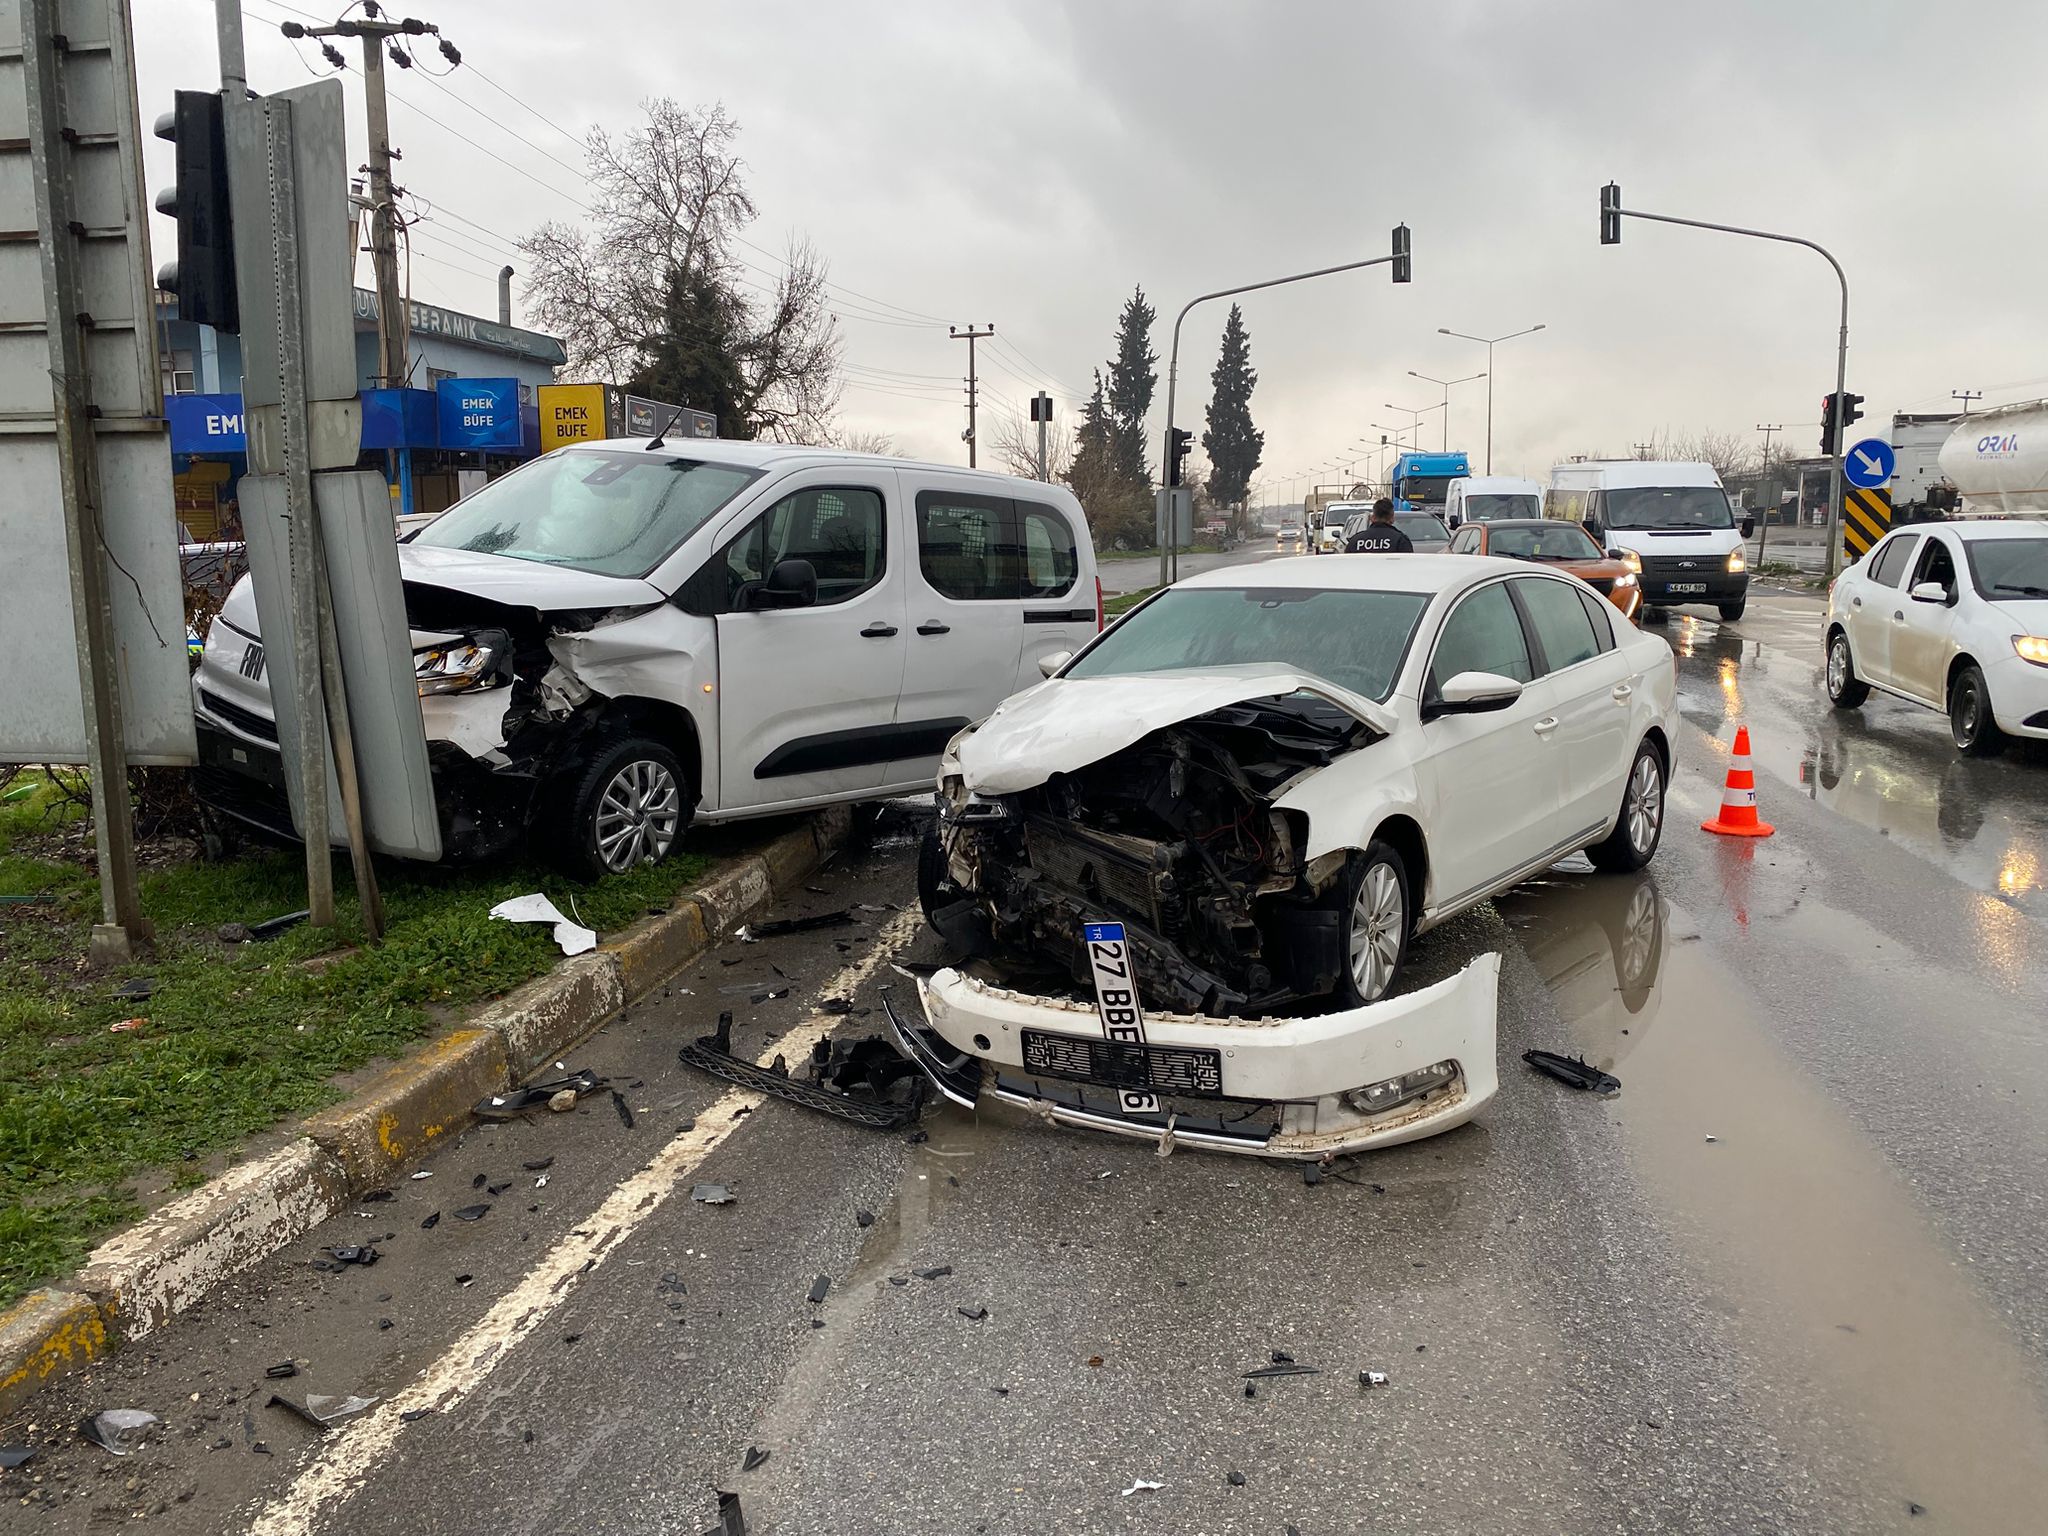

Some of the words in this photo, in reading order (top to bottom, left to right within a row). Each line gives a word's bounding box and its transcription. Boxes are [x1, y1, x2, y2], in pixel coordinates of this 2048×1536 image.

[462, 398, 494, 409] EMEK
[463, 414, 494, 427] BÜFE
[555, 406, 589, 420] EMEK
[206, 414, 246, 435] EM
[557, 421, 589, 437] BÜFE
[1091, 942, 1127, 978] 27
[1123, 1092, 1155, 1109] 6
